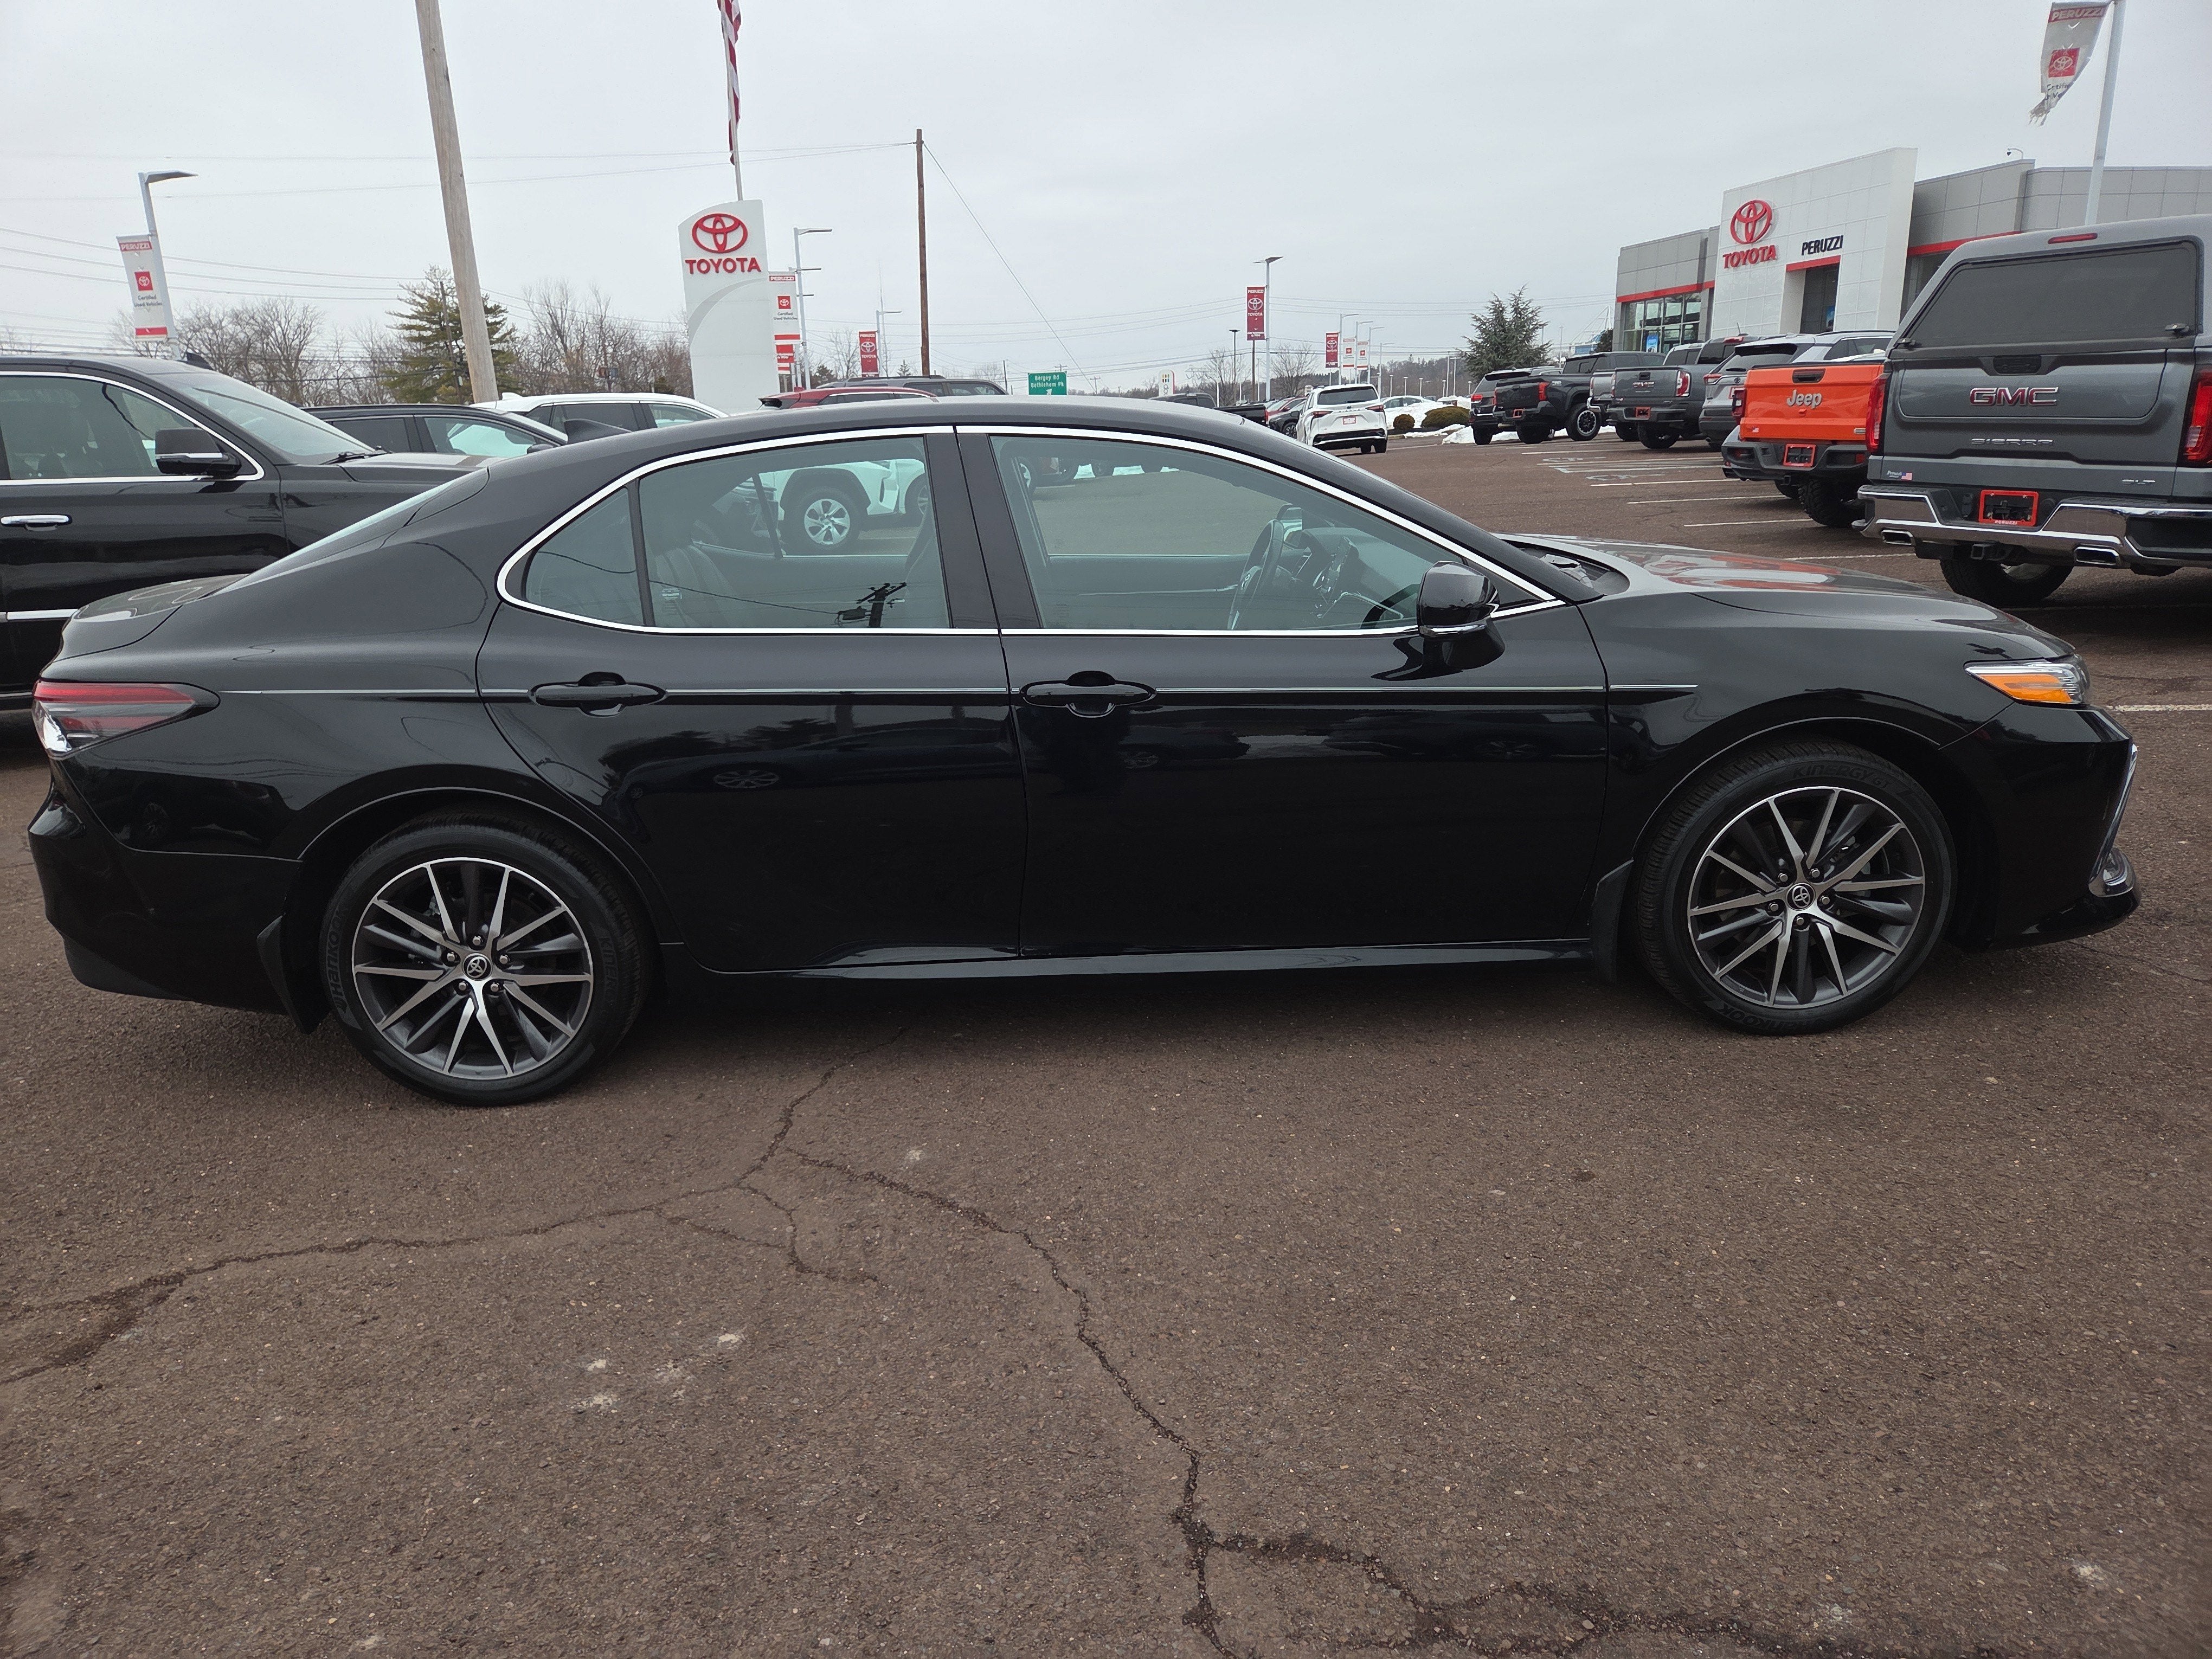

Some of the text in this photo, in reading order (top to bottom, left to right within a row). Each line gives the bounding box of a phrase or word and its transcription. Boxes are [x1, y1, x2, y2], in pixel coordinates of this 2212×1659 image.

[1801, 235, 1844, 256] PERUZZI
[685, 257, 762, 274] TOYOTA
[1722, 245, 1778, 269] TOYOTA
[1786, 389, 1823, 409] Jeep
[1970, 387, 2059, 406] GMC
